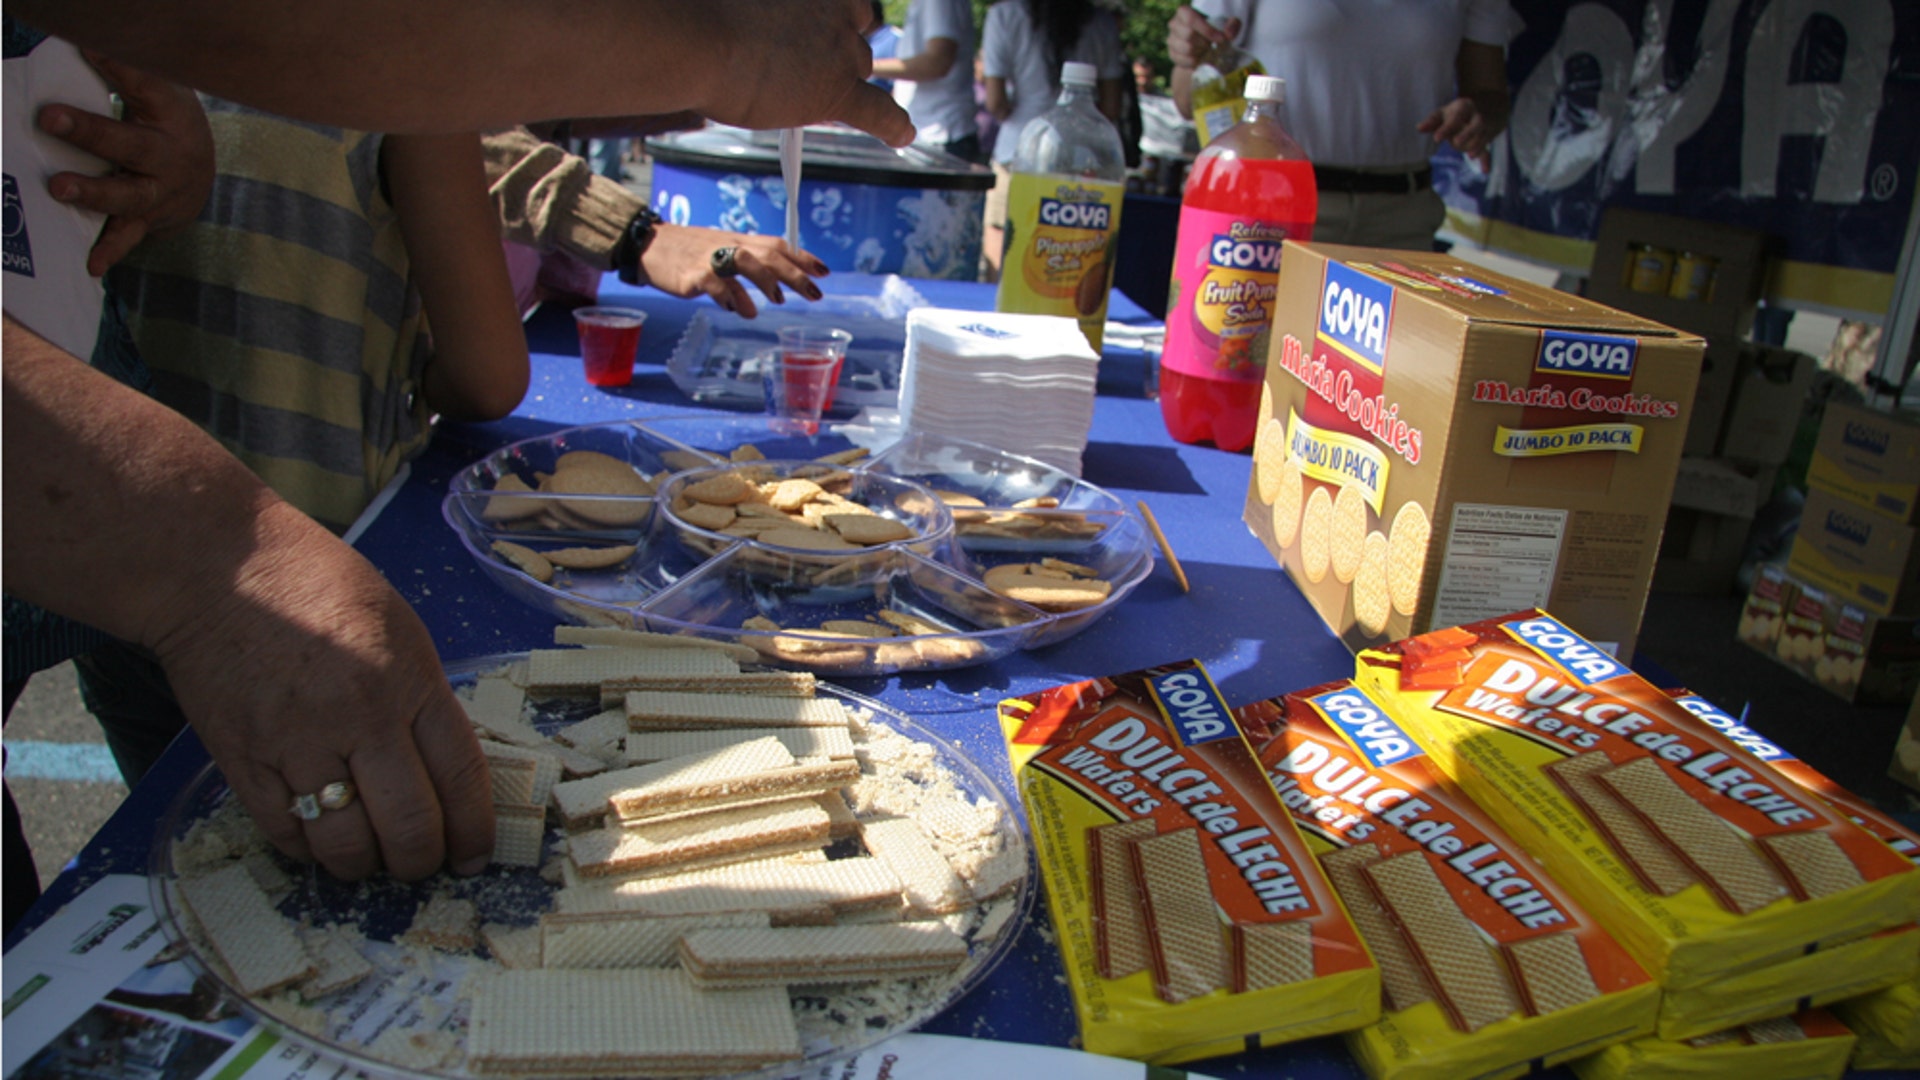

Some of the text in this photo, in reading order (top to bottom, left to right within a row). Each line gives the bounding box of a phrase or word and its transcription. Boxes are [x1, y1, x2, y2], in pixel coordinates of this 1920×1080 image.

[1484, 0, 1897, 204] OYA
[1042, 201, 1109, 227] GOYA
[1044, 256, 1081, 275] Soda
[1204, 281, 1243, 304] Fruit
[1224, 303, 1265, 325] Soda
[1323, 280, 1386, 355] GOYA
[1543, 339, 1630, 371] GOYA
[1334, 369, 1422, 466] Cookies
[1567, 386, 1679, 419] Cookies
[1291, 429, 1380, 492] JUMBO 10 PACK
[1503, 429, 1633, 450] JUMBO 10 PACK
[1517, 619, 1619, 682] GOYA
[1158, 672, 1227, 742] GOYA
[1324, 694, 1412, 765] GOYA
[1463, 687, 1601, 749] Wafers
[1676, 699, 1782, 761] GOYA
[1482, 658, 1816, 827] DULCE de LECHE
[1058, 745, 1162, 816] Wafers
[1266, 770, 1377, 842] Wafers
[1089, 715, 1311, 916] DULCE de LECHE
[1275, 740, 1434, 830] DULCE
[1406, 819, 1464, 855] de
[1446, 842, 1568, 931] LECHE
